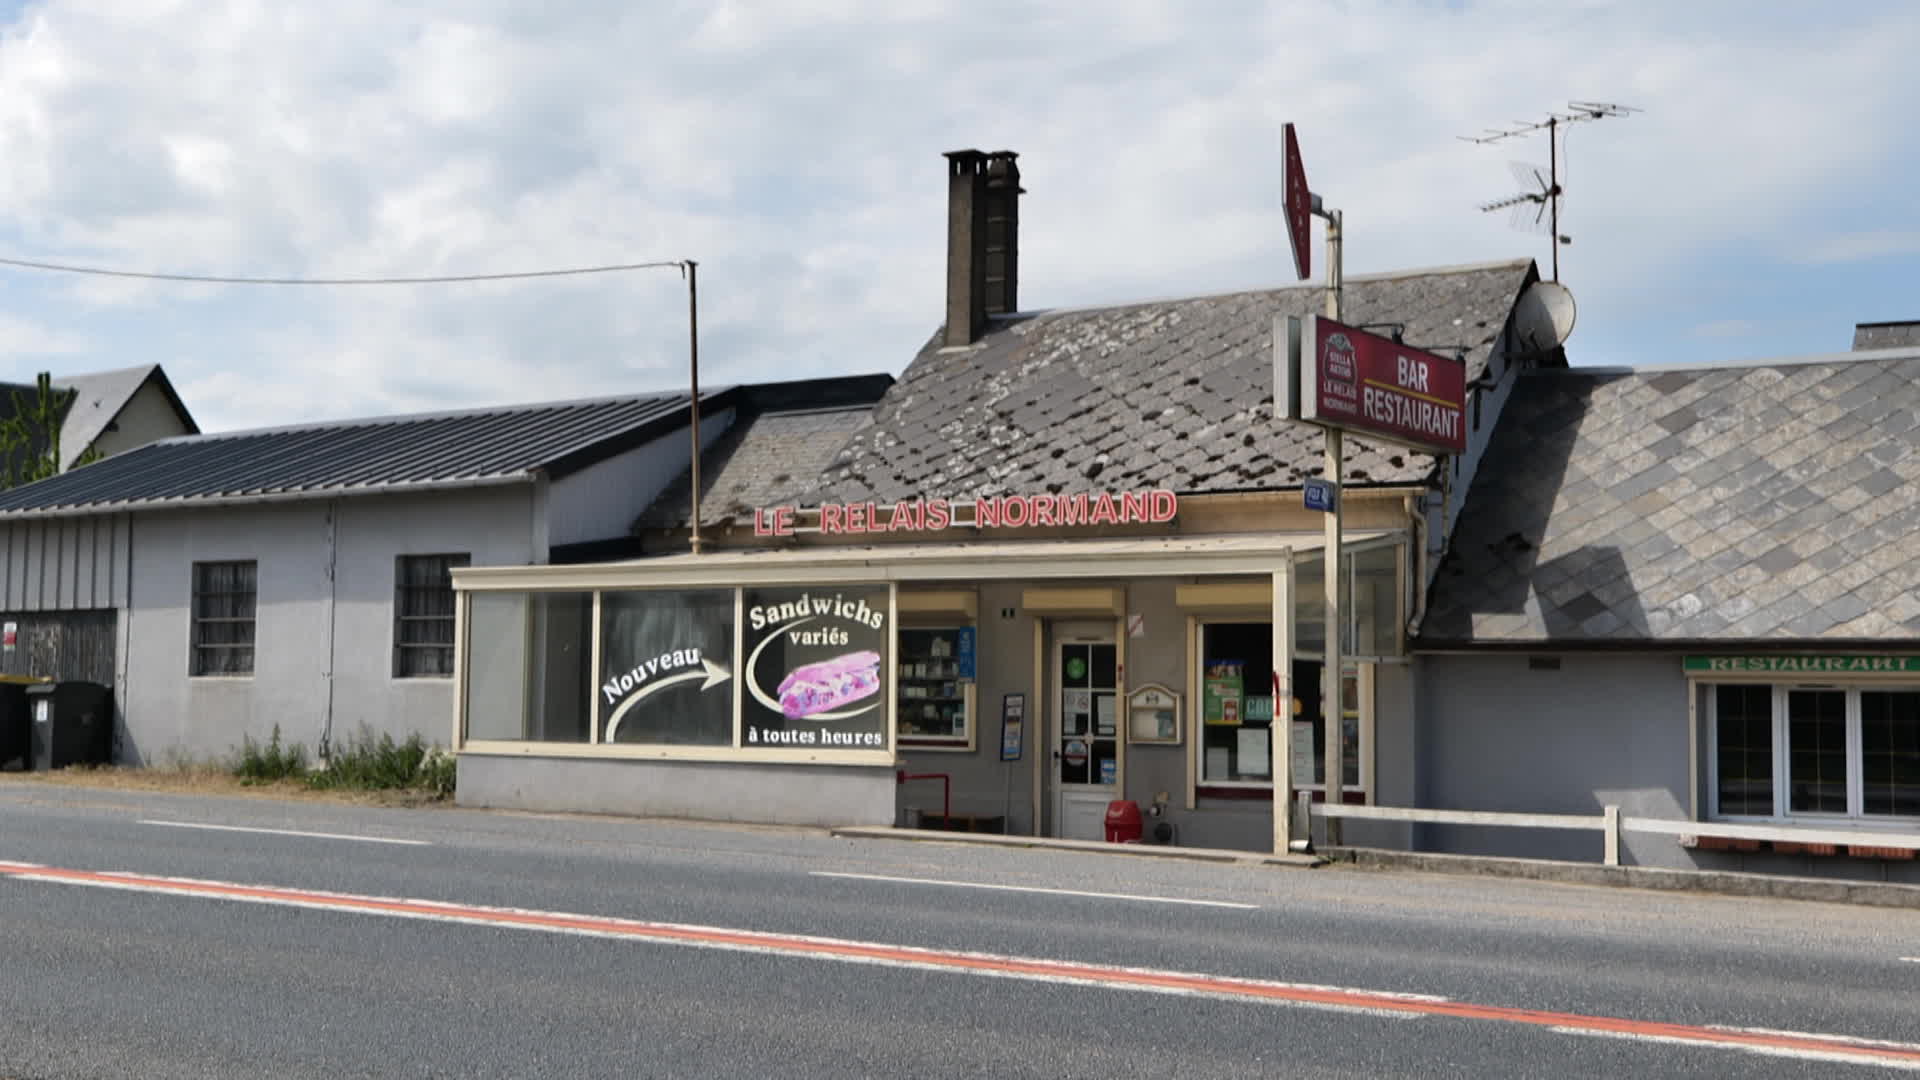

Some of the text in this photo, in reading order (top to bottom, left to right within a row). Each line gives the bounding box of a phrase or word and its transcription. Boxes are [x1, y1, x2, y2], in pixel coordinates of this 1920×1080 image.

[1398, 355, 1429, 392] BAR
[1364, 387, 1460, 440] RESTAURANT
[754, 490, 1178, 537] LE RELAIS NORMAND
[749, 593, 884, 630] Sandwichs
[790, 626, 849, 645] variés
[602, 648, 702, 705] Nouveau
[1710, 656, 1912, 672] RESTAURANT
[749, 727, 882, 746] à toutes heures
